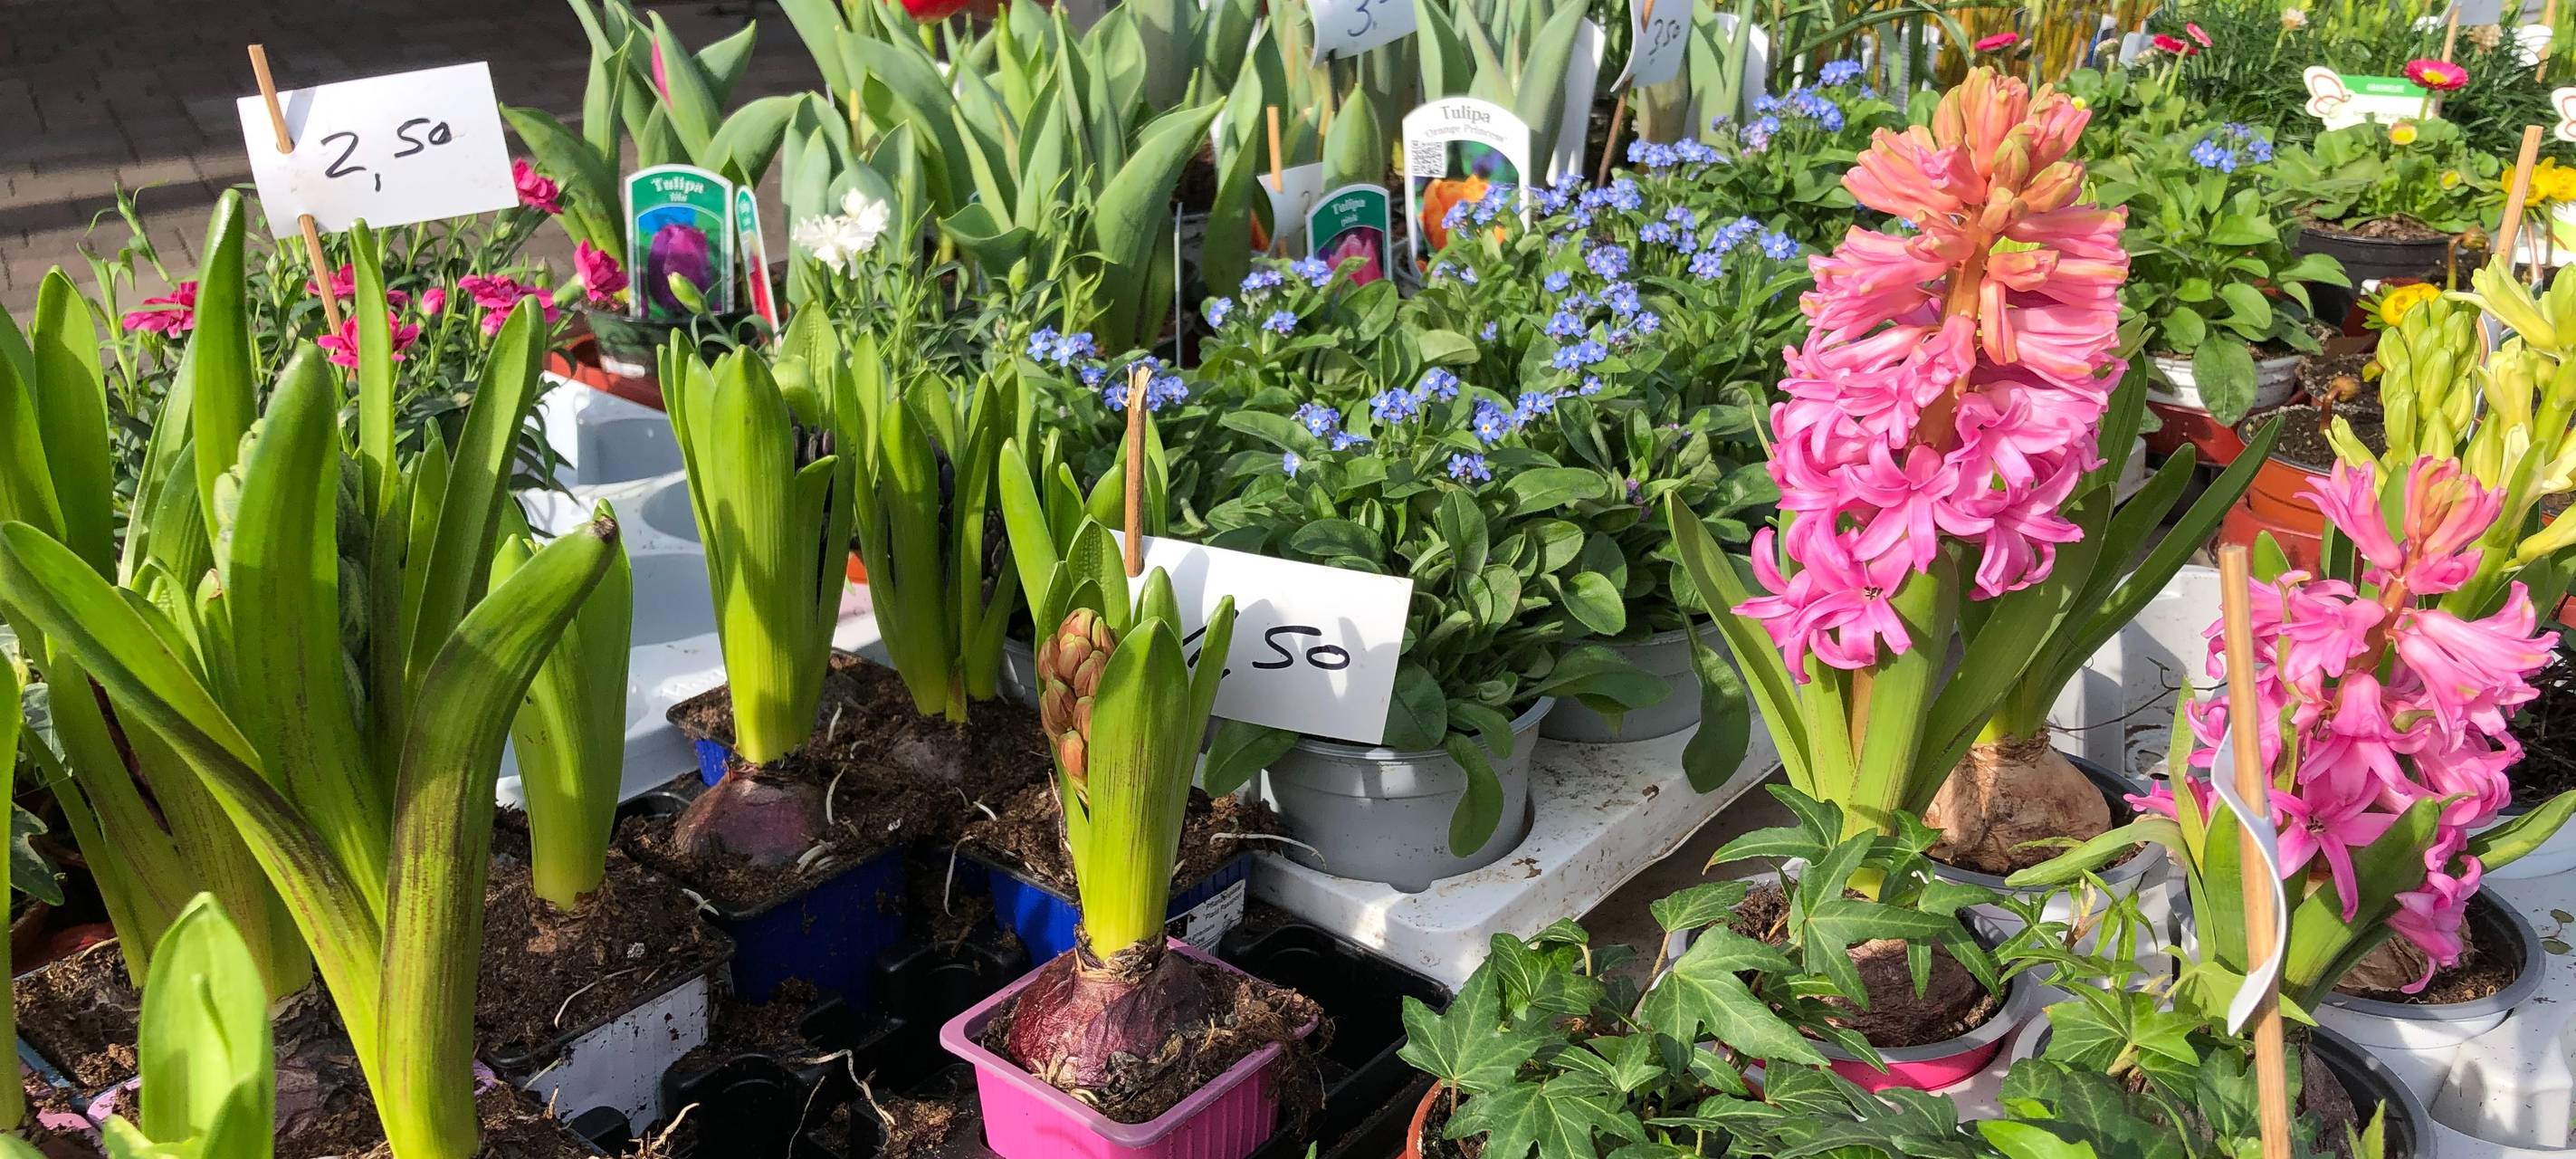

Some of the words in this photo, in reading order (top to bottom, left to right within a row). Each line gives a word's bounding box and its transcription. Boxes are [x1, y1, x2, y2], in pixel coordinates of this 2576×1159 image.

[1441, 105, 1491, 124] Tulipa
[320, 118, 453, 192] 2,50
[651, 176, 705, 195] Tulipa
[1331, 198, 1367, 215] Tulipa
